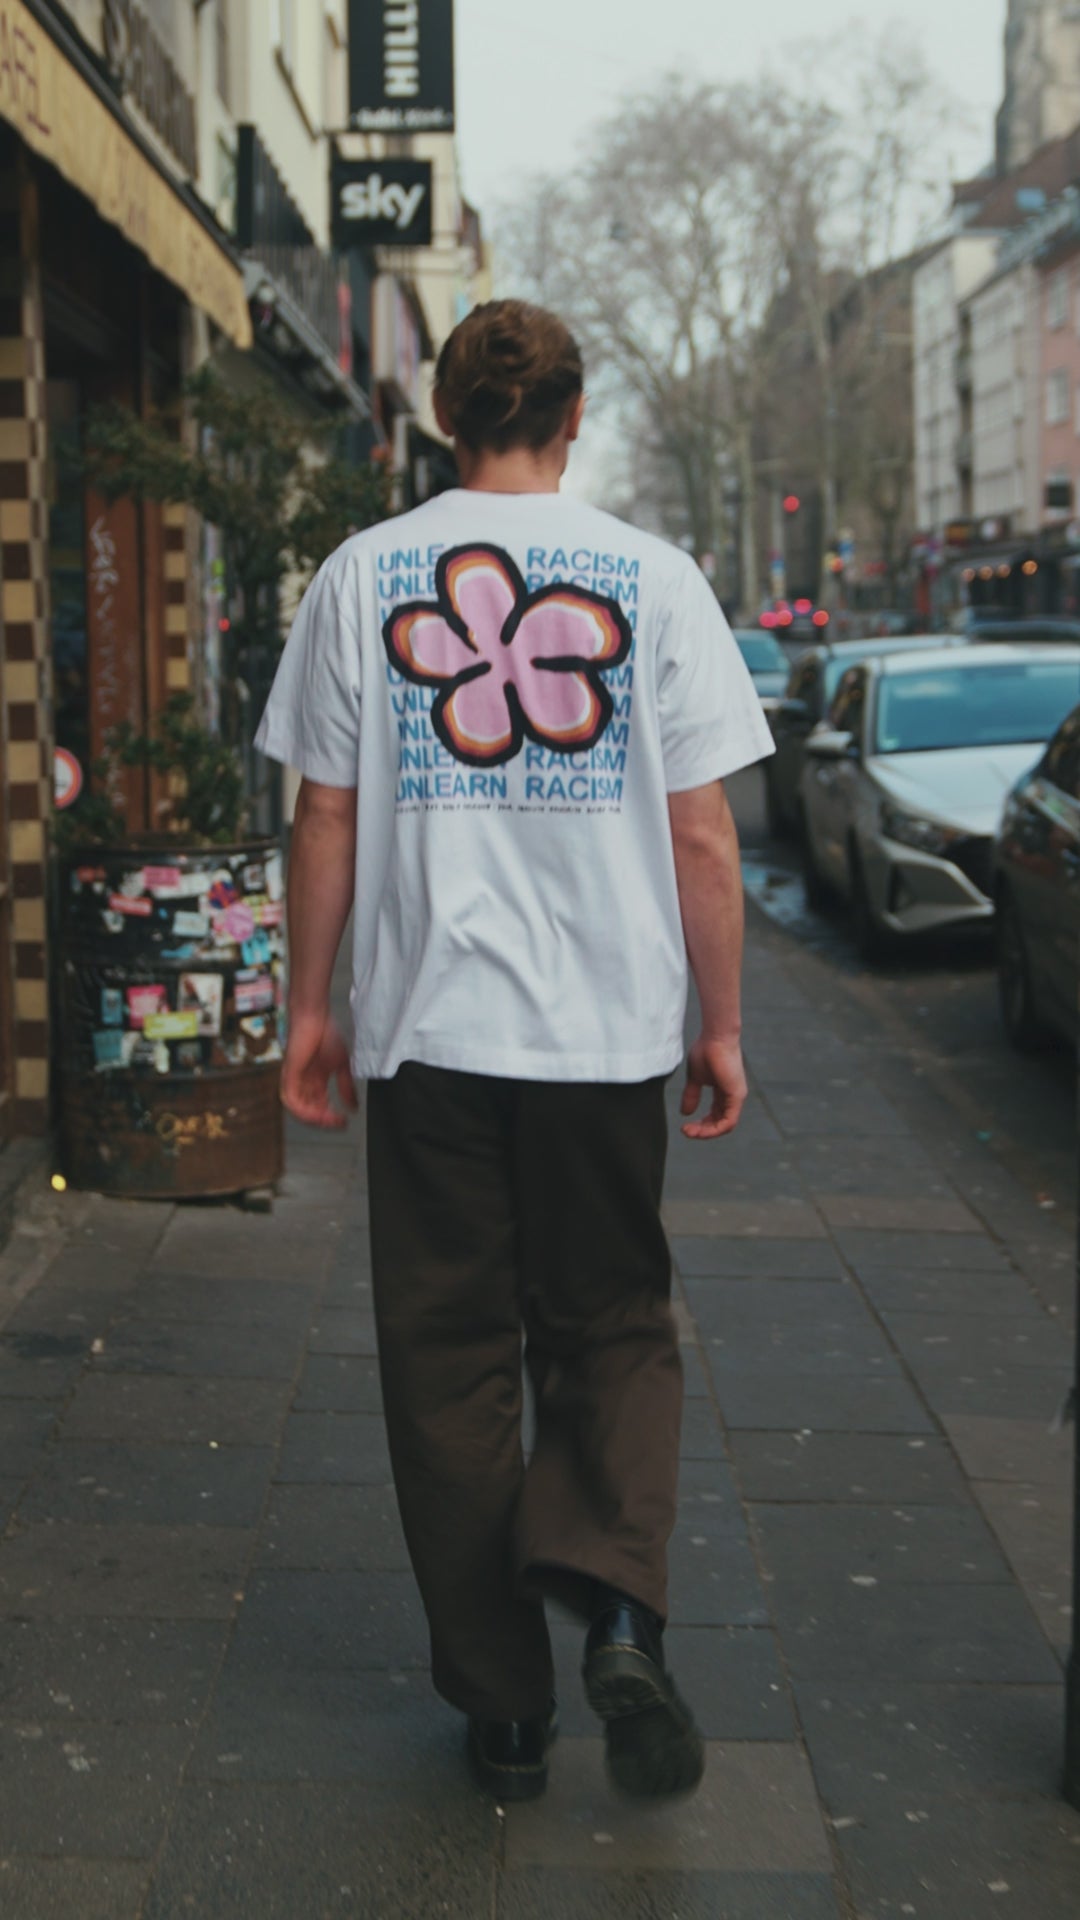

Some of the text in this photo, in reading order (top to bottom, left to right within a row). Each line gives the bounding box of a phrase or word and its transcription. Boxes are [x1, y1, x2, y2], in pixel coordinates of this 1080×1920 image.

[384, 0, 419, 97] HILL
[341, 172, 426, 230] sky
[378, 543, 640, 579] UNLE RACISM
[524, 742, 627, 774] RACISM
[395, 771, 624, 803] UNLEARN RACISM
